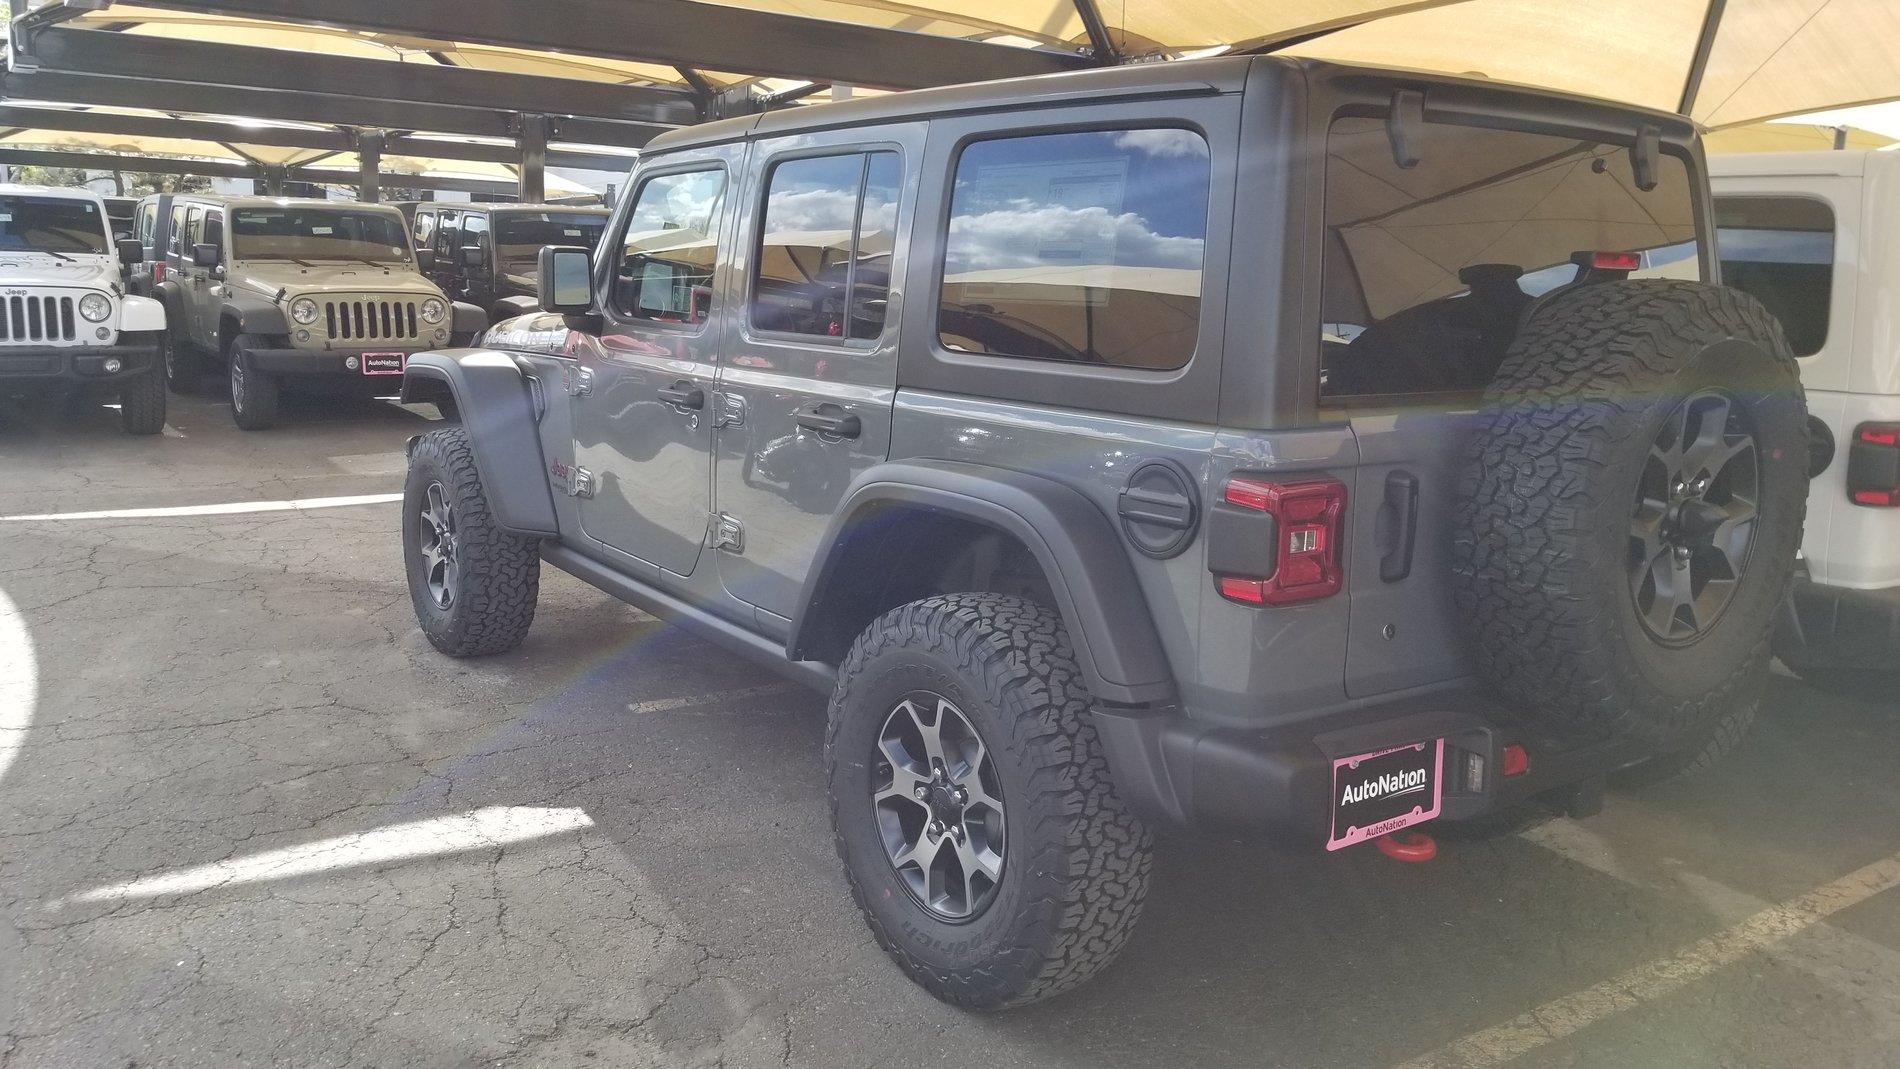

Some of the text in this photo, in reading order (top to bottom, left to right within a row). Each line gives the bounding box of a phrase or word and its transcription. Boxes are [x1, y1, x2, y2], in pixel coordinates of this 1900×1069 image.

[361, 294, 380, 302] Jeep
[367, 359, 400, 367] AutoNation
[1341, 768, 1426, 806] AutoNation
[1365, 818, 1407, 838] AutoNation
